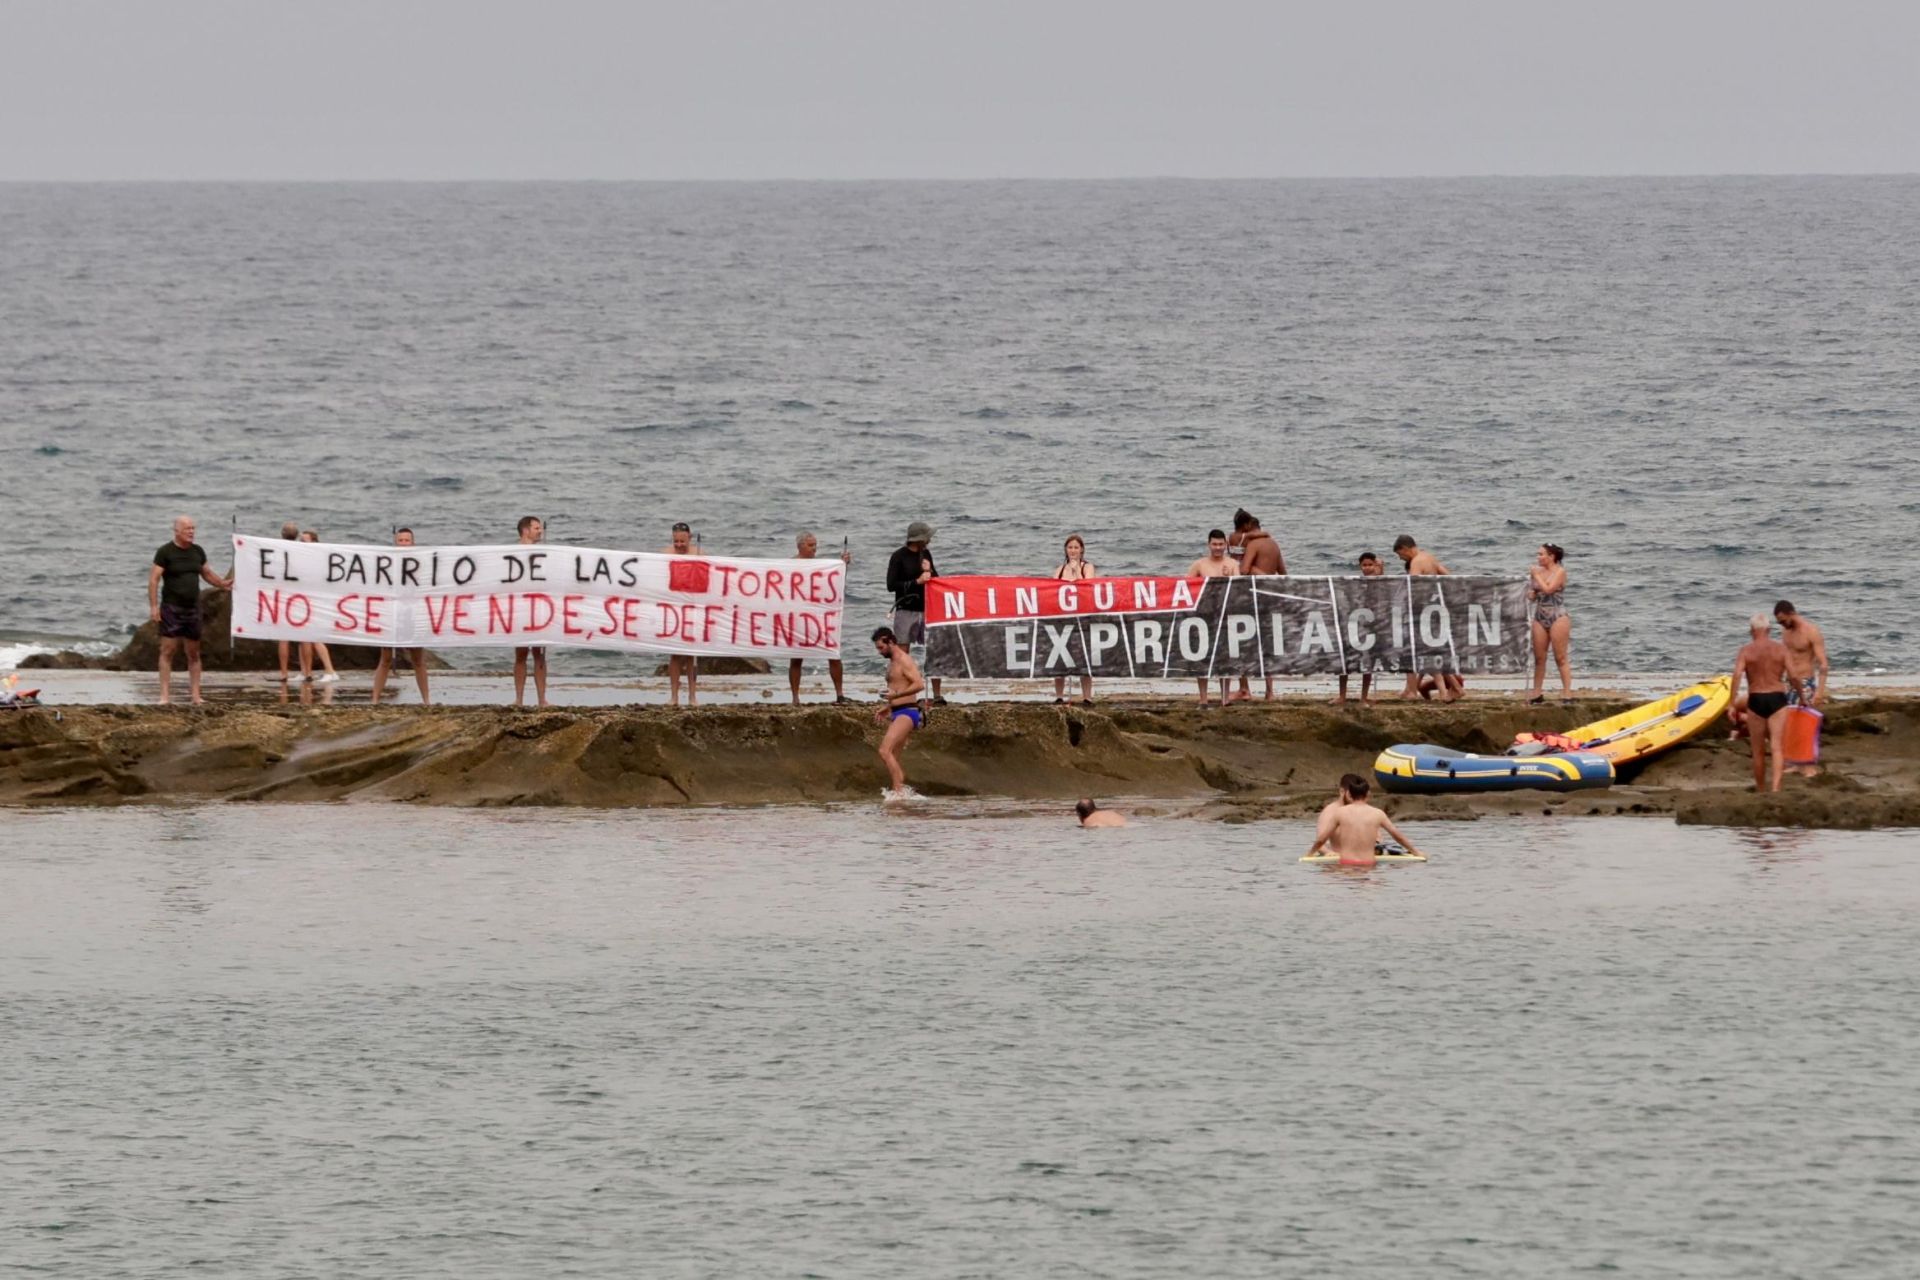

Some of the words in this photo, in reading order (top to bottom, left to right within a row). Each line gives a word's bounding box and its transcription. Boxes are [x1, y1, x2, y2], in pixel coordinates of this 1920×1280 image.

[259, 549, 298, 581] EL
[501, 553, 547, 583] DE
[575, 555, 638, 587] LAS
[257, 589, 311, 628] NO
[335, 595, 384, 633] SE
[944, 579, 1194, 619] NINGUNA
[1005, 592, 1501, 670] EXPROPIACIÓN
[1360, 657, 1400, 672] LAS
